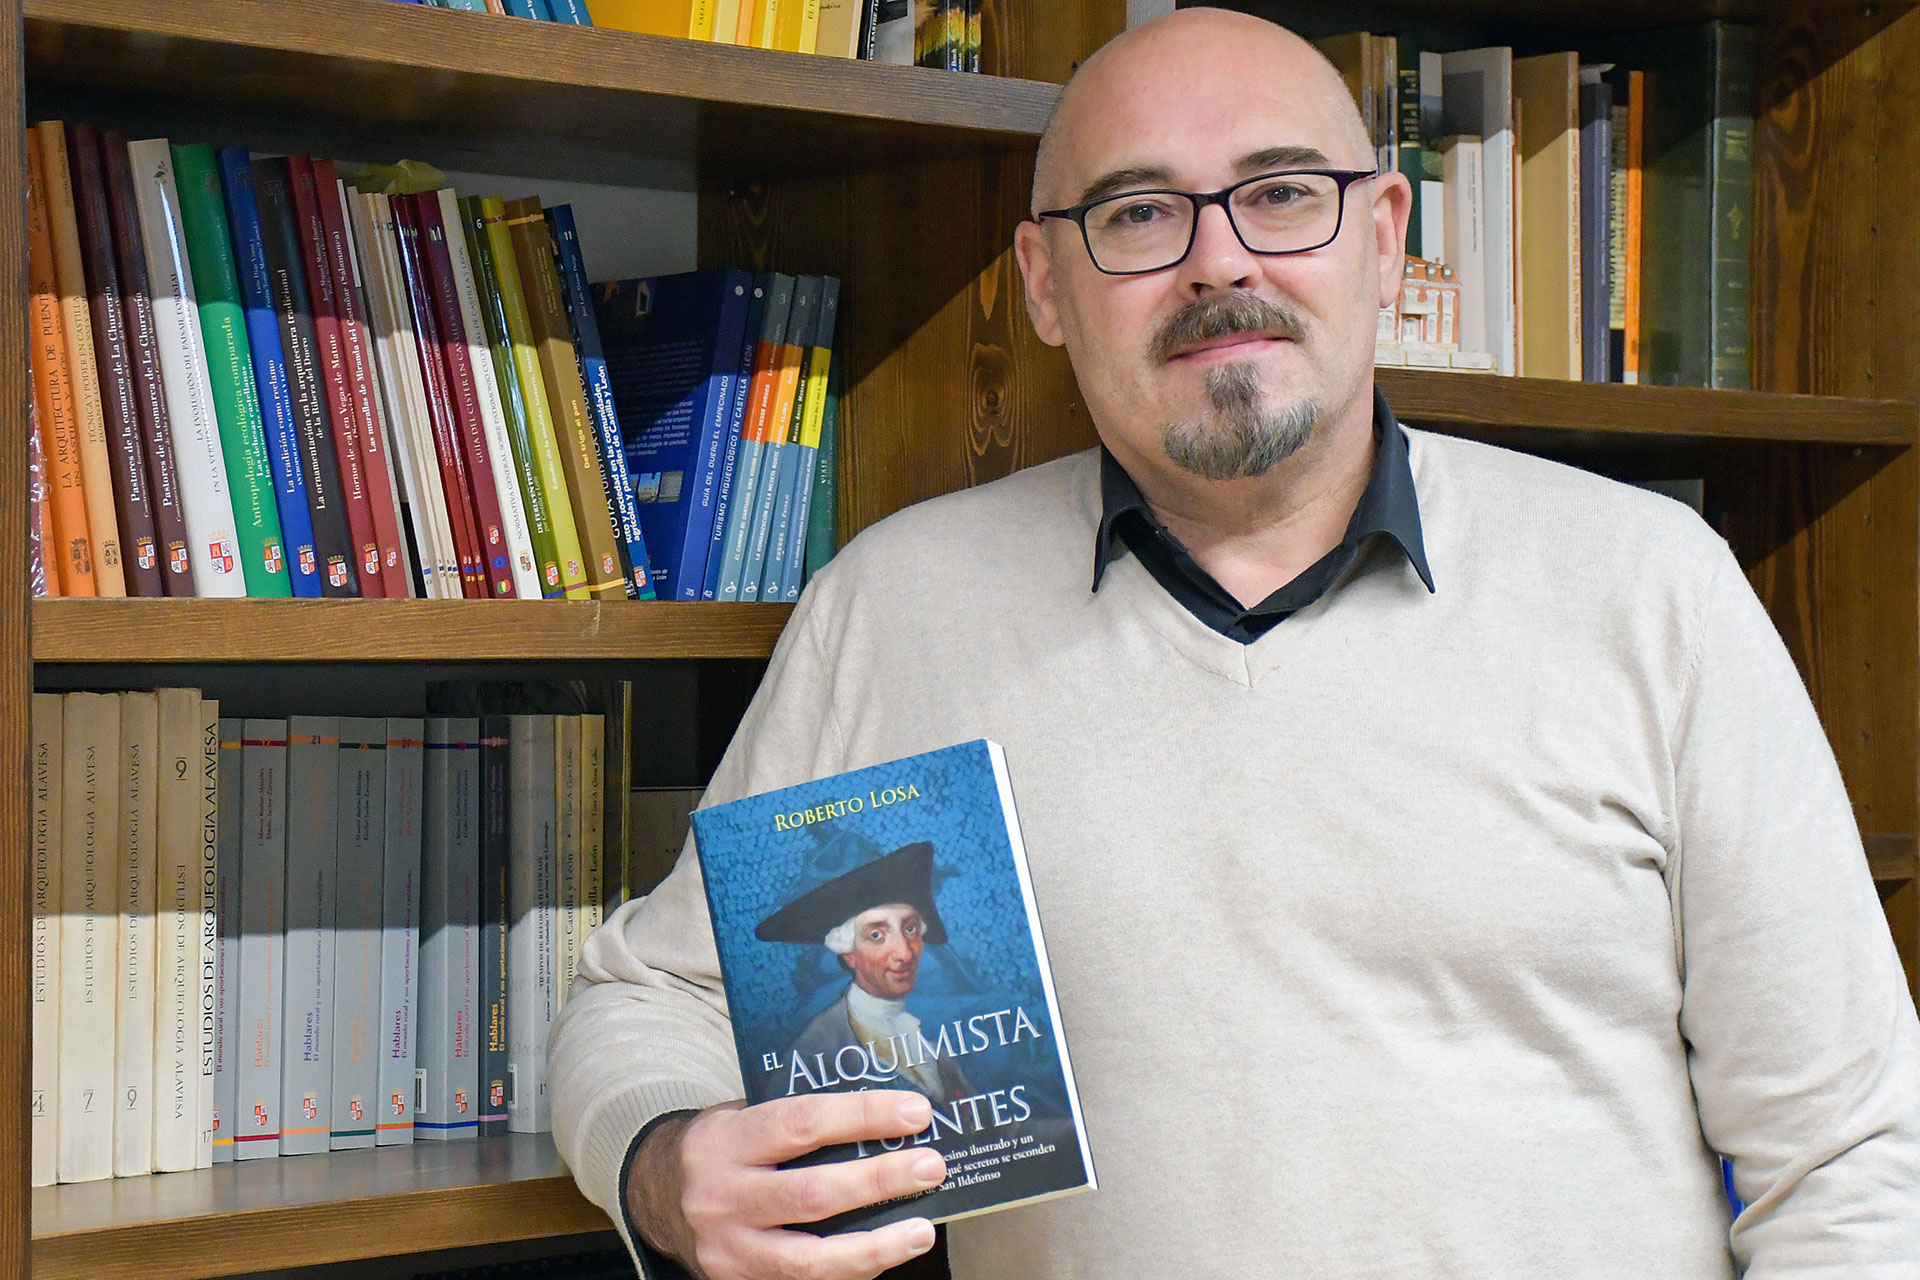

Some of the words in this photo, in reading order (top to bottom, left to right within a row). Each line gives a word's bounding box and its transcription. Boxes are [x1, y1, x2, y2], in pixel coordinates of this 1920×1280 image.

[475, 219, 483, 230] 6
[331, 230, 348, 285] (Salamanca)
[37, 281, 54, 336] PUENTES
[101, 285, 119, 341] Churrería
[277, 268, 295, 324] tradicional
[341, 287, 355, 326] Castañar
[463, 277, 477, 317] CASTILLA
[132, 291, 149, 347] Churrería
[348, 327, 358, 343] del
[471, 318, 480, 329] DE
[45, 344, 57, 361] DE
[109, 343, 121, 358] La
[112, 360, 123, 375] de
[140, 348, 152, 364] La
[220, 316, 242, 386] comparada
[287, 326, 306, 390] arquitectura
[299, 336, 311, 365] Duero
[327, 333, 341, 369] Matute
[351, 344, 365, 381] Miranda
[474, 329, 489, 373] CULTURAL
[142, 366, 154, 380] de
[239, 365, 254, 418] castellanas
[265, 359, 280, 400] reclamo
[304, 367, 314, 382] del
[333, 371, 343, 384] de
[357, 383, 367, 395] de
[596, 365, 608, 389] León
[117, 377, 129, 424] comarca
[148, 382, 161, 429] comarca
[297, 391, 308, 402] la
[301, 404, 310, 417] en
[307, 383, 319, 414] Ribera
[335, 385, 349, 415] Vegas
[483, 373, 500, 424] PATRIMONIO
[571, 399, 580, 416] pan
[603, 389, 611, 397] y
[713, 375, 729, 427] EMPECINADO
[734, 377, 748, 418] CASTILLA
[48, 368, 69, 465] ARQUITECTURA
[231, 389, 251, 445] ecológica
[274, 401, 285, 429] como
[312, 416, 321, 426] la
[342, 416, 350, 429] en
[360, 396, 374, 435] murallas
[574, 417, 582, 427] al
[592, 382, 612, 443] comunidades
[603, 398, 618, 433] Castilla
[731, 420, 740, 432] EN
[121, 426, 132, 437] la
[122, 438, 134, 453] de
[152, 430, 163, 442] la
[248, 419, 260, 459] dehesas
[314, 428, 323, 439] de
[342, 430, 353, 446] cal
[366, 436, 377, 452] Las
[494, 425, 505, 451] SOBRE
[576, 428, 588, 451] trigo
[611, 434, 621, 448] de
[712, 428, 720, 439] EL
[154, 443, 165, 458] de
[254, 460, 263, 476] Las
[277, 430, 293, 477] tradición
[302, 419, 323, 494] ornamentación
[345, 448, 355, 461] de
[581, 453, 590, 469] Del
[605, 444, 615, 458] las
[610, 458, 618, 471] en
[707, 440, 718, 468] DUERO
[719, 434, 738, 500] ARQUEOLÓGICO
[60, 472, 72, 488] LA
[124, 455, 140, 501] Pastores
[156, 459, 172, 506] Pastores
[285, 479, 295, 493] La
[347, 462, 362, 500] Hornos
[499, 451, 513, 490] GENERAL
[613, 448, 631, 493] pastoriles
[704, 469, 713, 485] DEL
[241, 453, 264, 528] Antropología
[314, 495, 325, 510] La
[611, 472, 627, 514] sociedad
[508, 492, 524, 539] NORMATIVA
[625, 501, 642, 542] agrícolas
[714, 502, 727, 541] TURISMO
[37, 741, 48, 801] ALAVESA
[85, 744, 95, 804] ALAVESA
[130, 743, 139, 801] ALAVESA
[203, 722, 215, 804] ALAVESA
[773, 794, 865, 832] ROBERTO
[869, 781, 920, 808] LOSA
[36, 808, 49, 908] ARQUEOLOGIA
[85, 810, 96, 910] ARQUEOLOGIA
[129, 809, 140, 907] ARQUEOLOGIA
[565, 853, 573, 880] León
[589, 844, 597, 871] León
[176, 864, 186, 929] ESTUDIOS
[203, 810, 216, 951] ARQUEOLOGIA
[36, 913, 46, 930] DE
[84, 915, 94, 931] DE
[129, 912, 137, 928] DE
[565, 893, 573, 934] Castilla
[589, 886, 597, 927] Castilla
[176, 934, 185, 951] DE
[403, 938, 411, 984] aportaciones
[567, 939, 573, 951] en
[35, 935, 45, 1002] ESTUDIOS
[84, 936, 93, 1003] ESTUDIOS
[128, 933, 137, 999] ESTUDIOS
[203, 955, 214, 979] DE
[172, 956, 185, 1053] ARQUEOLOGIA
[202, 984, 214, 1075] ESTUDIOS
[303, 1011, 313, 1061] Hablares
[392, 1009, 401, 1058] Hablares
[489, 1003, 497, 1051] Hablares
[761, 1050, 784, 1071] EL
[786, 1005, 1042, 1095] ALQUIMISTA
[83, 1091, 93, 1111] 7
[127, 1089, 137, 1107] 9
[174, 1060, 184, 1119] ALAVESA
[855, 1084, 1032, 1158] NTES
[944, 1163, 963, 1178] qué
[963, 1156, 1000, 1171] secretos
[1000, 1154, 1011, 1163] se
[1011, 1141, 1055, 1160] esconden
[968, 1137, 1011, 1155] ilustrado
[1011, 1138, 1018, 1148] y
[1020, 1135, 1033, 1144] un
[938, 1180, 955, 1191] San
[956, 1168, 1001, 1187] Ildefonso
